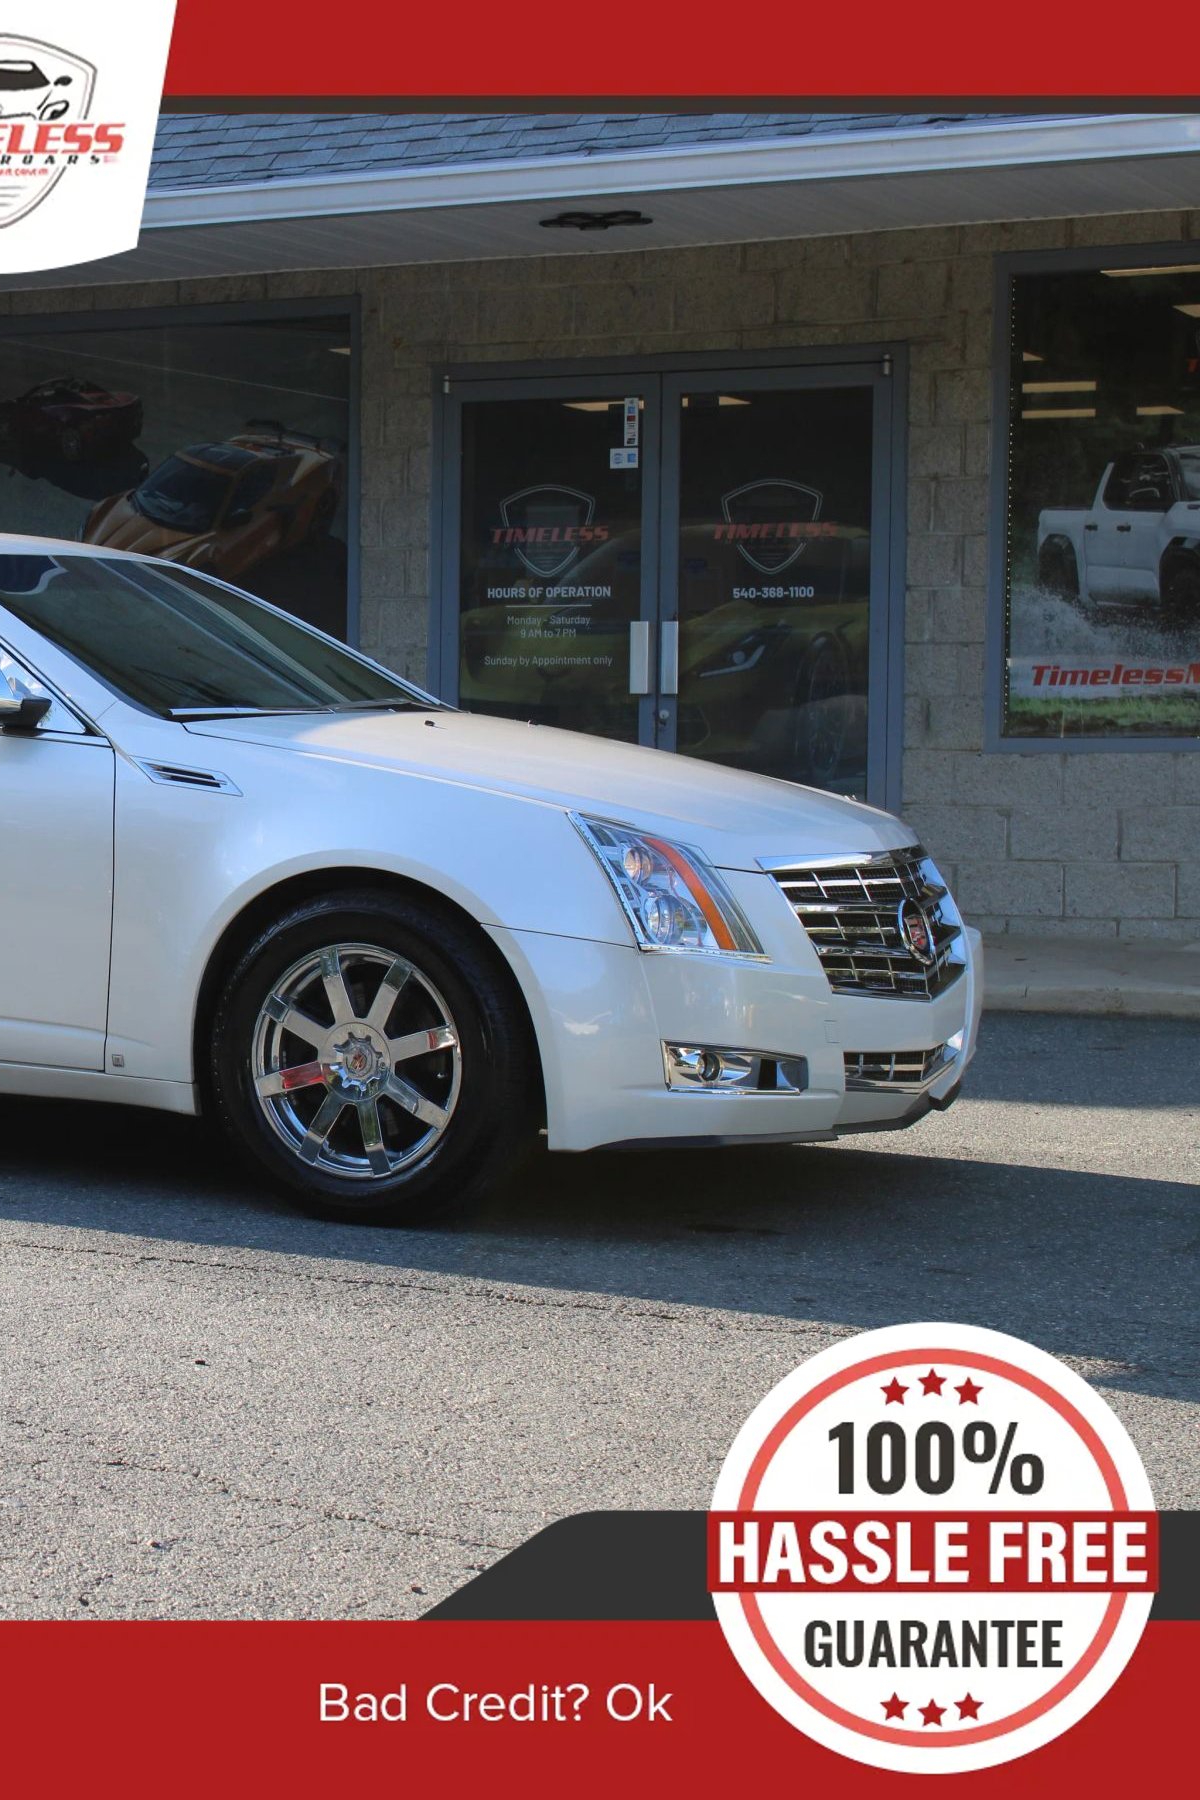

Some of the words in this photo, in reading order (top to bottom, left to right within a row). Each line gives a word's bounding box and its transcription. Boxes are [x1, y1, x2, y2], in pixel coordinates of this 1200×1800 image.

[489, 525, 609, 544] TIMELESS
[712, 522, 838, 540] TIMELESS
[487, 587, 526, 599] HOURS
[528, 587, 544, 598] OF
[545, 586, 612, 598] OPERATION
[732, 586, 815, 599] 540-368-1100
[506, 615, 541, 627] Monday
[549, 615, 591, 627] Saturday
[520, 629, 526, 638] 9
[528, 629, 542, 638] AM
[543, 629, 554, 638] to
[555, 628, 561, 637] 7
[562, 628, 577, 638] PM
[484, 655, 518, 668] Sunday
[519, 656, 531, 668] by
[531, 655, 592, 667] Appointment
[593, 655, 614, 667] only
